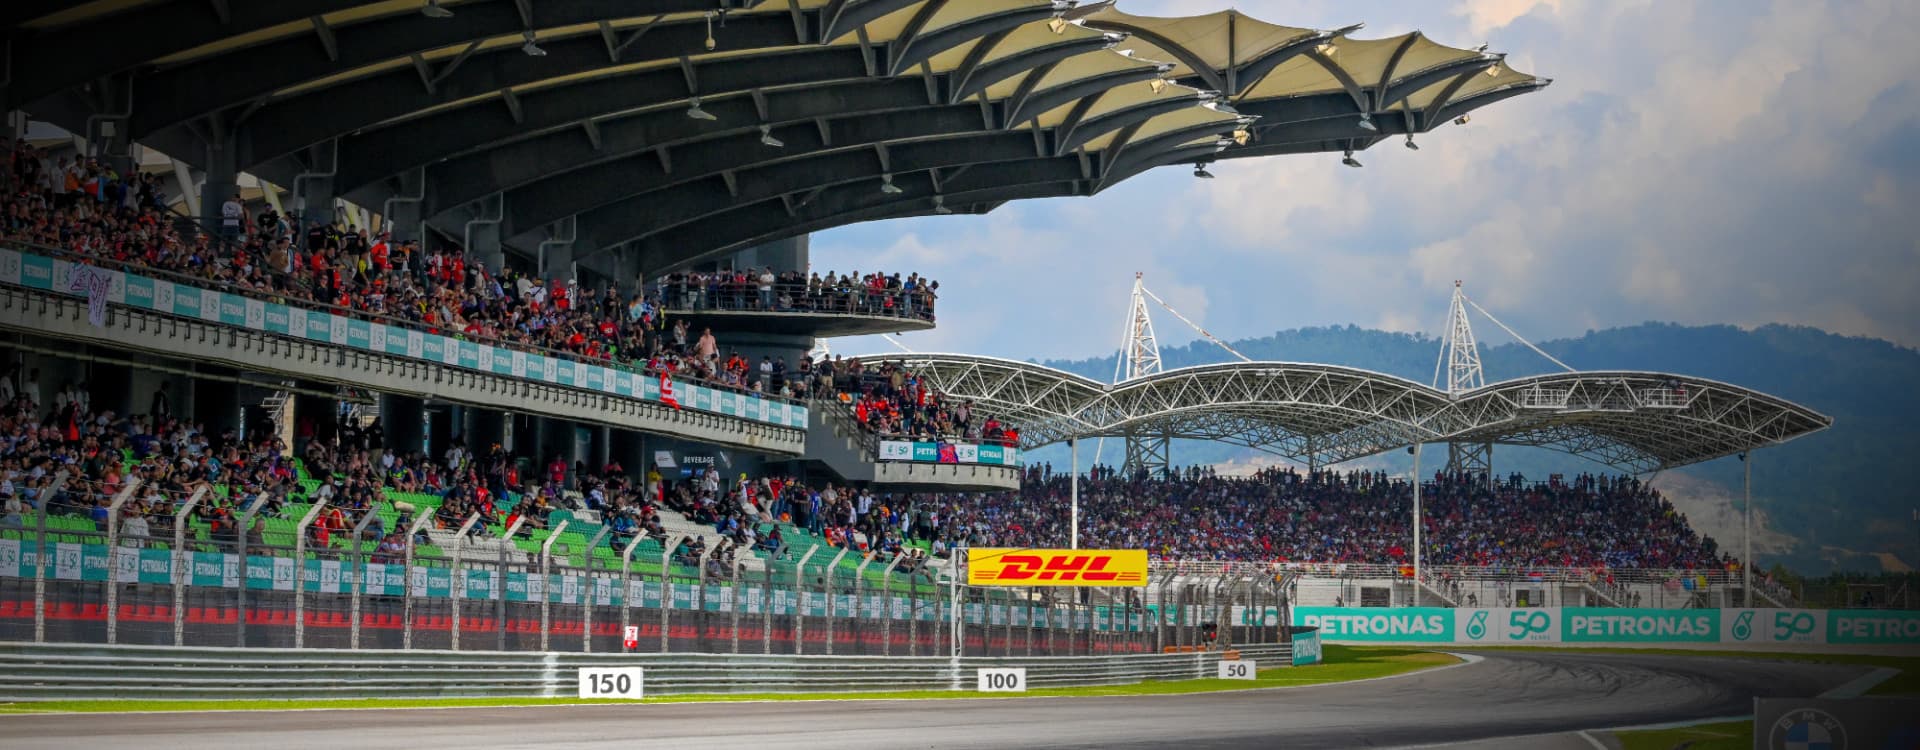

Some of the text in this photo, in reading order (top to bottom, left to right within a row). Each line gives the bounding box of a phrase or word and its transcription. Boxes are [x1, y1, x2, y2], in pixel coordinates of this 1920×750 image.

[683, 456, 715, 464] BEVERAGE
[997, 555, 1118, 580] DHL
[1304, 615, 1444, 635] PETRONAS
[1571, 616, 1711, 636] PETRONAS
[1228, 664, 1247, 677] 50
[588, 673, 632, 695] 150
[986, 673, 1018, 689] 100
